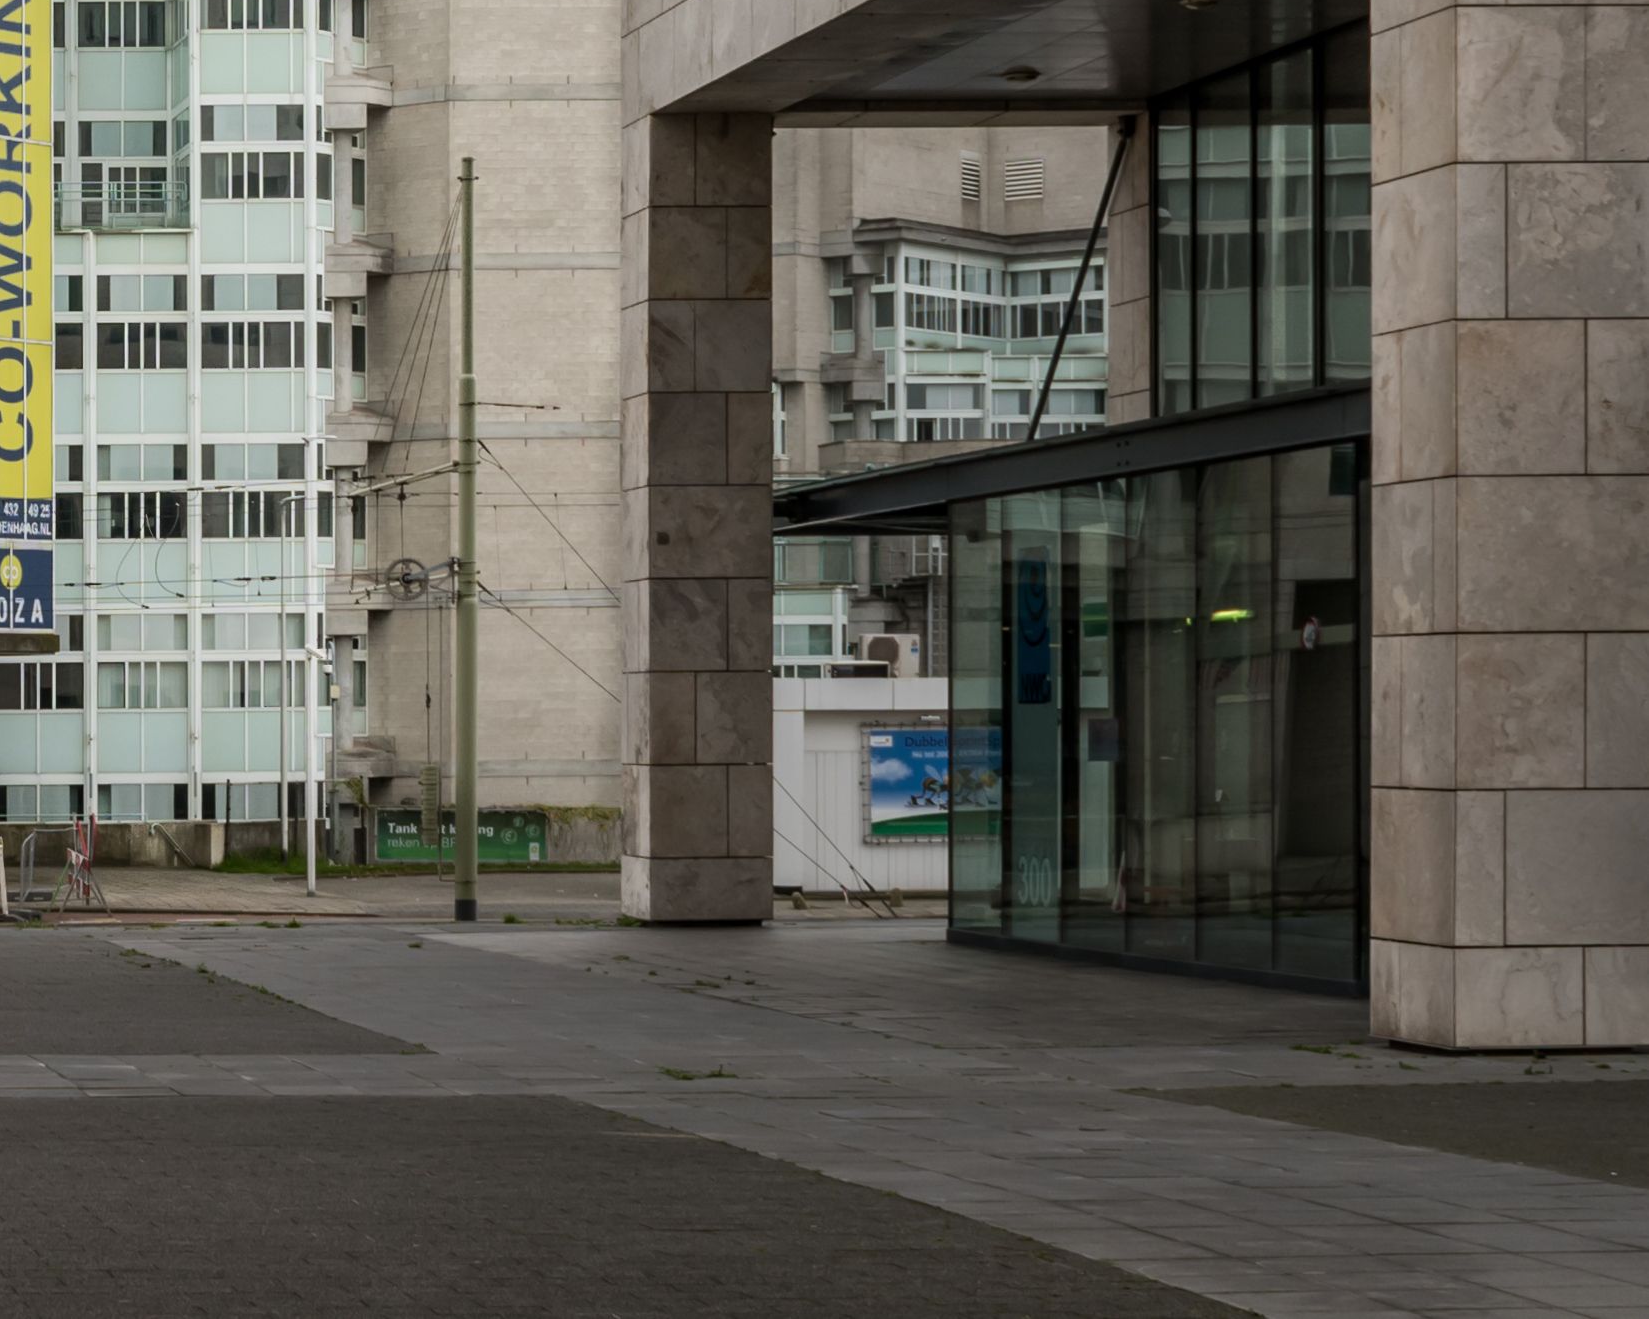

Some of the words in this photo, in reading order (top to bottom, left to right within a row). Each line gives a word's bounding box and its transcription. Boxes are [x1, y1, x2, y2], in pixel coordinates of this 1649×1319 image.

[3, 502, 19, 516] 432
[388, 823, 418, 834] Tank
[388, 837, 420, 848] reken
[1018, 856, 1051, 906] 300
